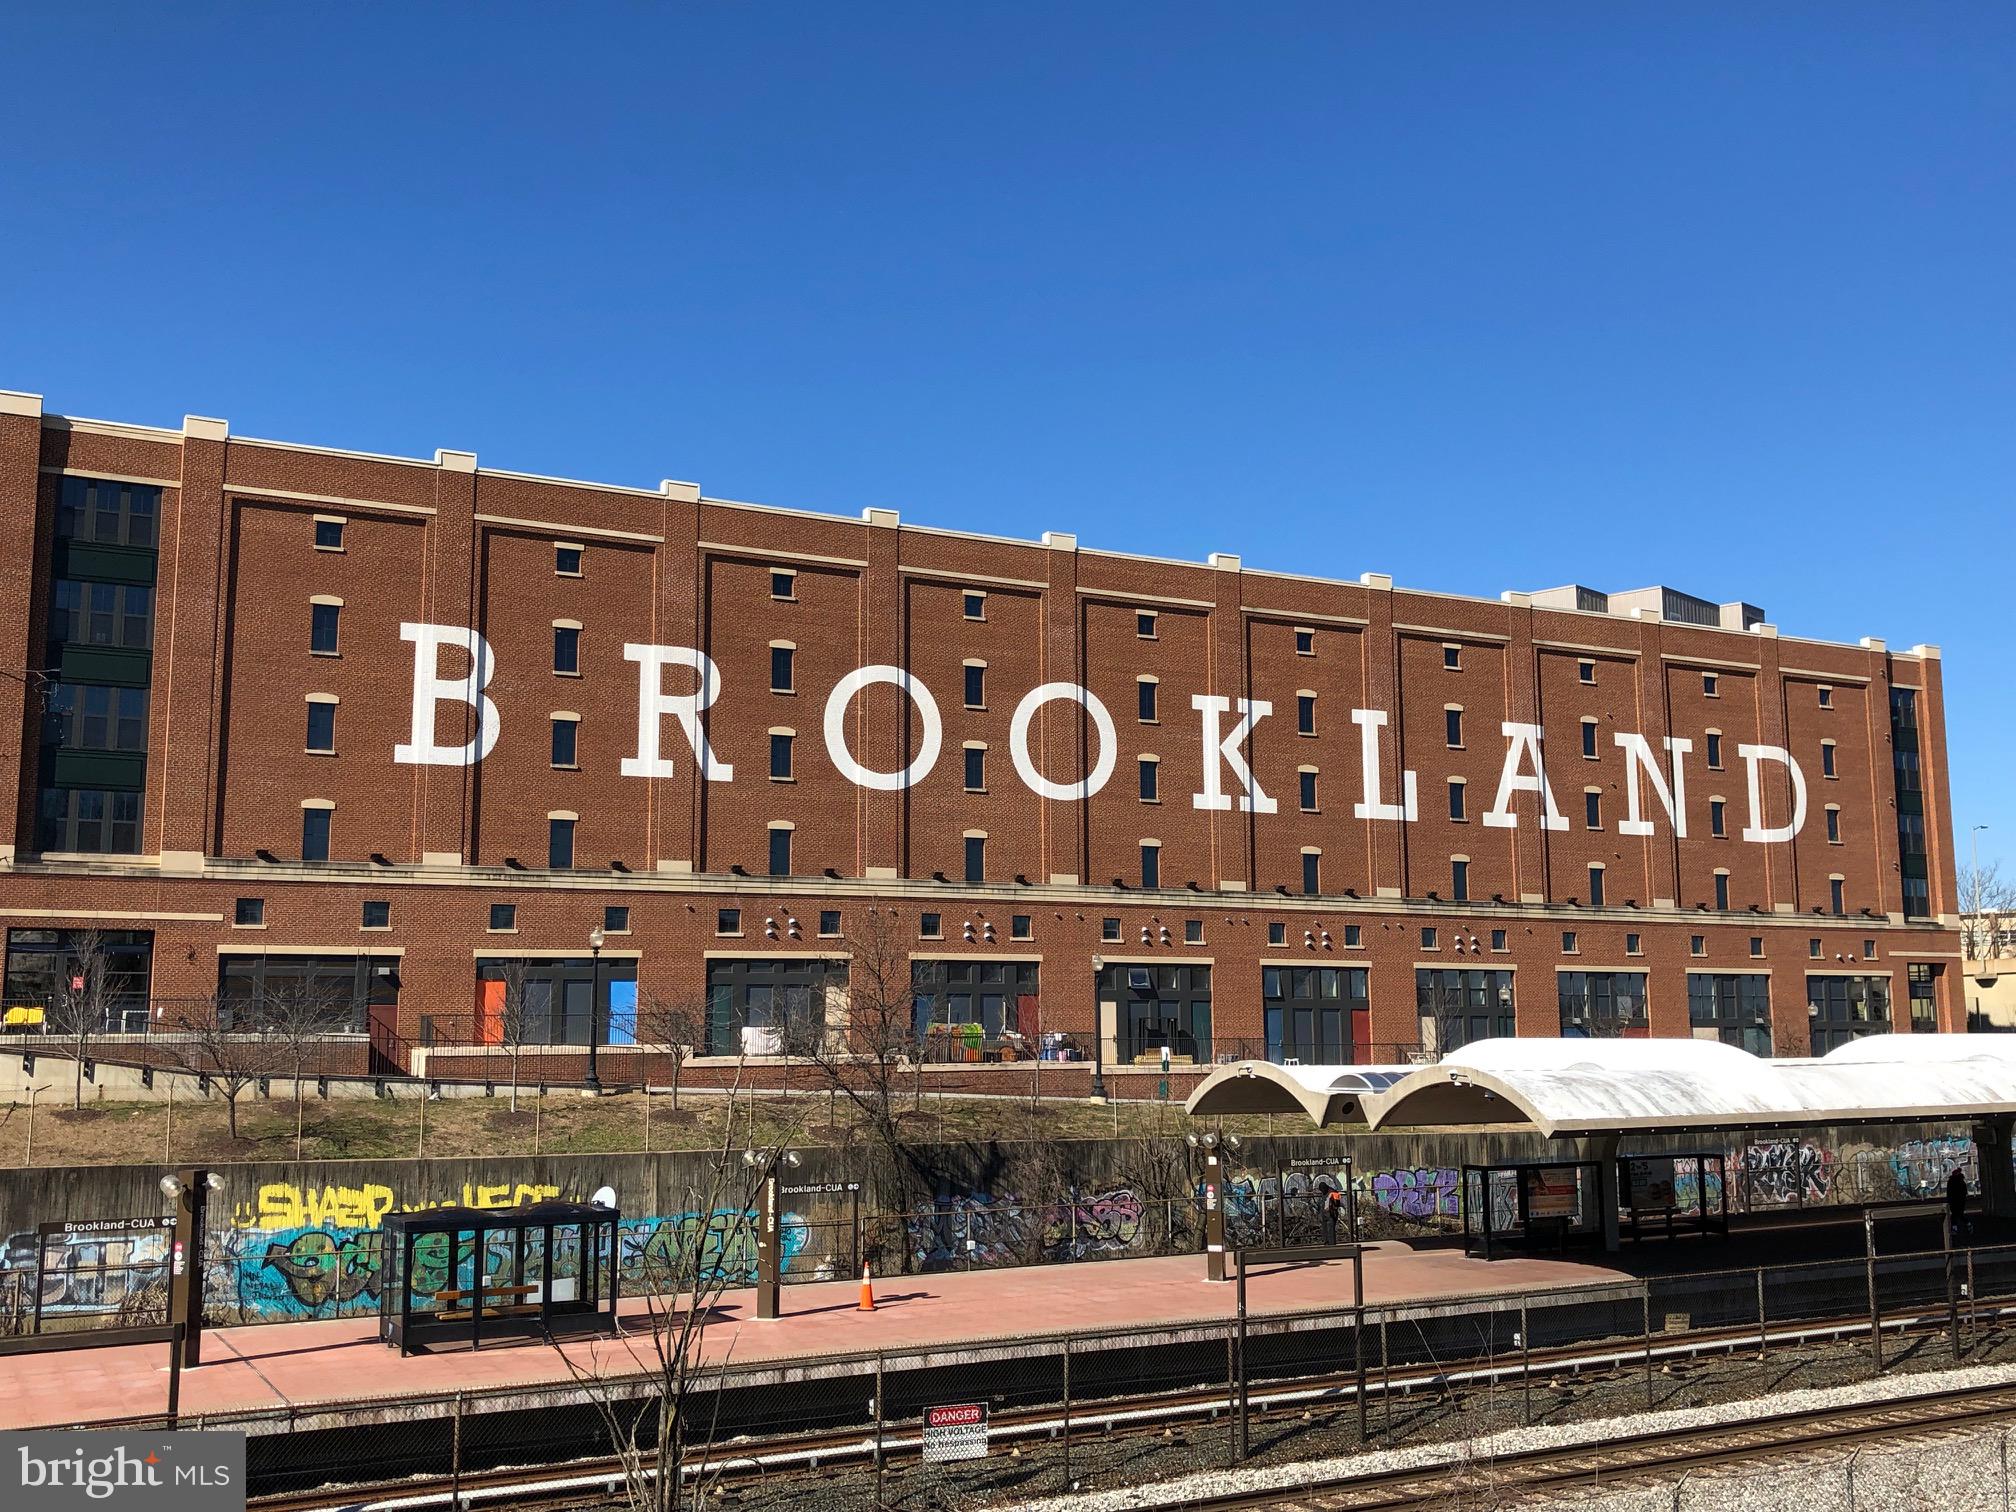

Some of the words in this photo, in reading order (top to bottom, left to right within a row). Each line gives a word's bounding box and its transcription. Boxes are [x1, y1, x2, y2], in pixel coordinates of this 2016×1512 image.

[393, 621, 1808, 844] BROOKLAND
[1290, 1157, 1340, 1167] Brookland-CUA
[64, 1218, 155, 1233] Brookland-CUA
[932, 1409, 980, 1424] DANGER
[924, 1428, 947, 1438] HIGH
[948, 1425, 987, 1437] VOLTAGE
